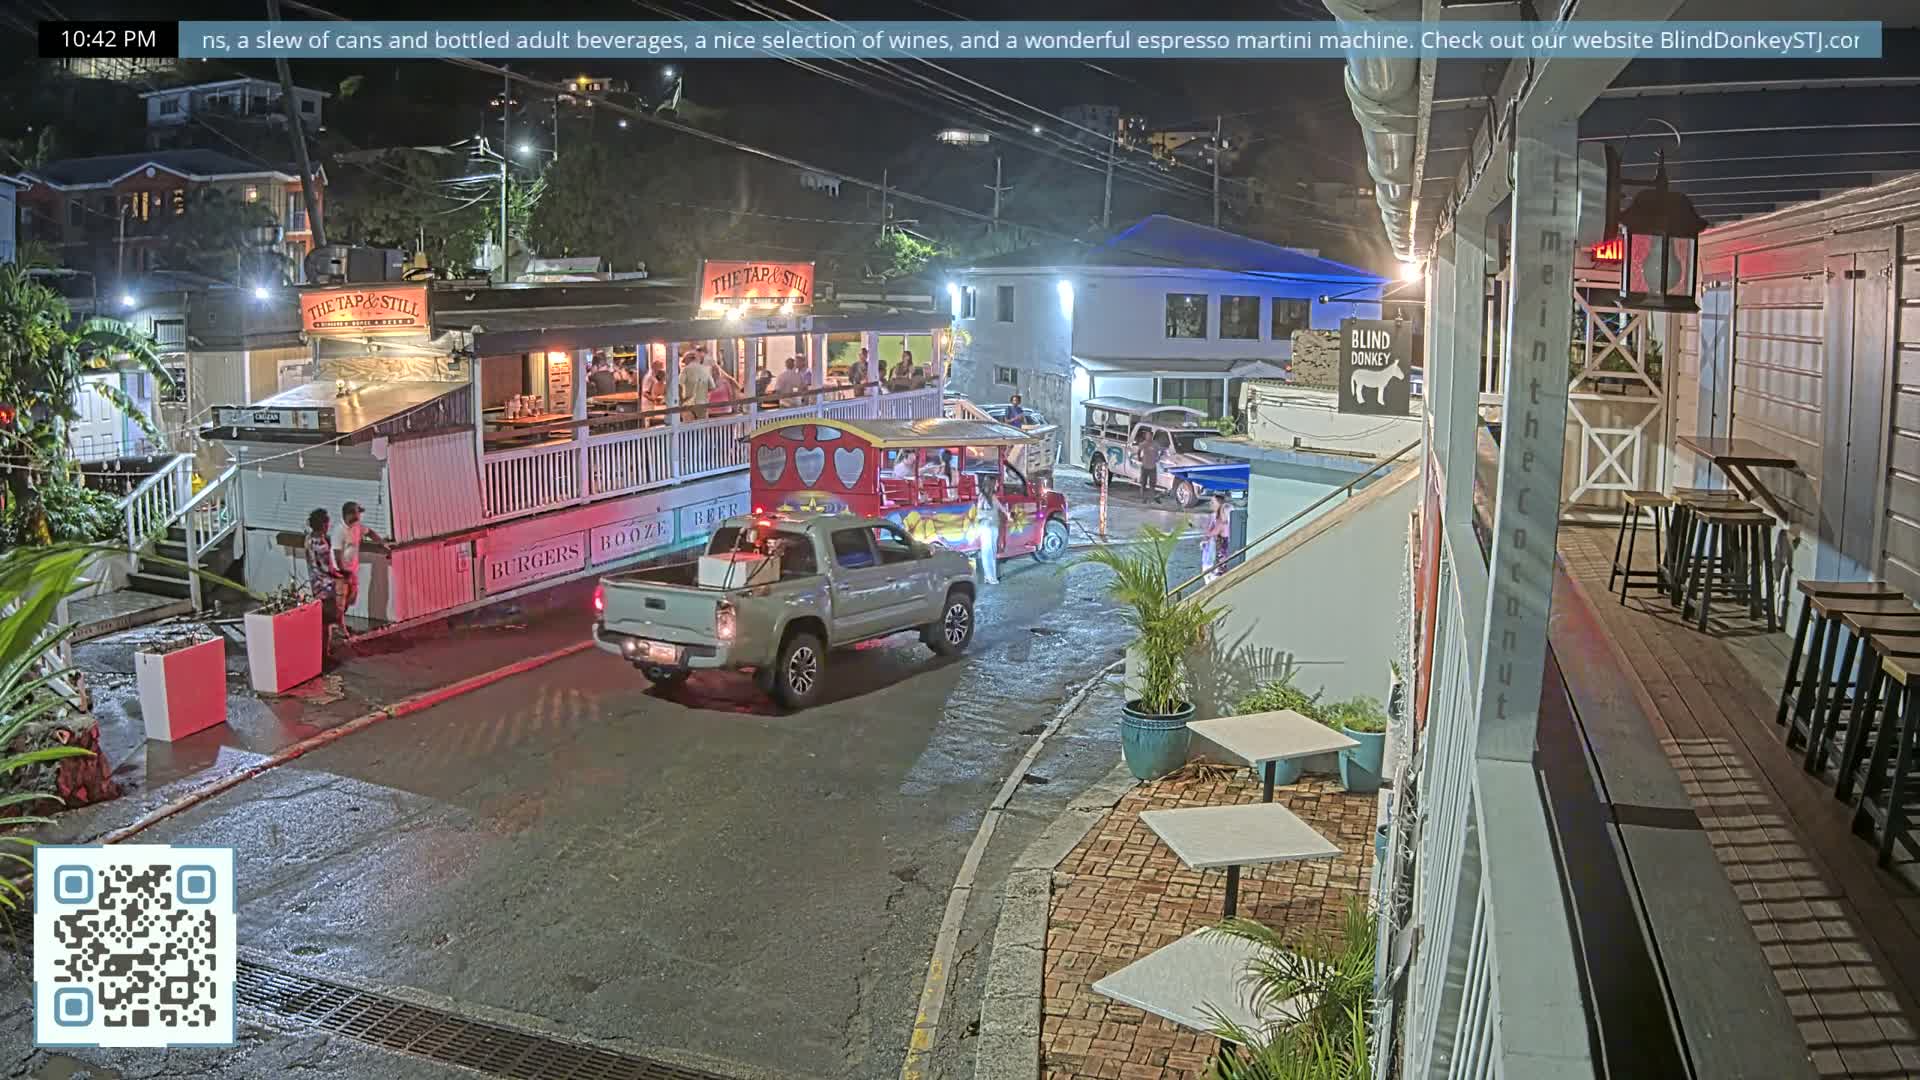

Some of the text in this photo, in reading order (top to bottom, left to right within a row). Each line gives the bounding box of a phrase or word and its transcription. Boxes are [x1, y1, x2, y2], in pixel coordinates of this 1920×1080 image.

[711, 270, 741, 295] THE
[743, 266, 770, 284] TAP
[783, 269, 808, 296] STILL
[307, 298, 336, 320] THE
[335, 294, 364, 310] TAP
[380, 294, 420, 318] STILL
[1351, 329, 1391, 350] BLIND
[1351, 350, 1392, 367] DONKEY
[492, 502, 739, 580] BURGERS BOOZE BEER
